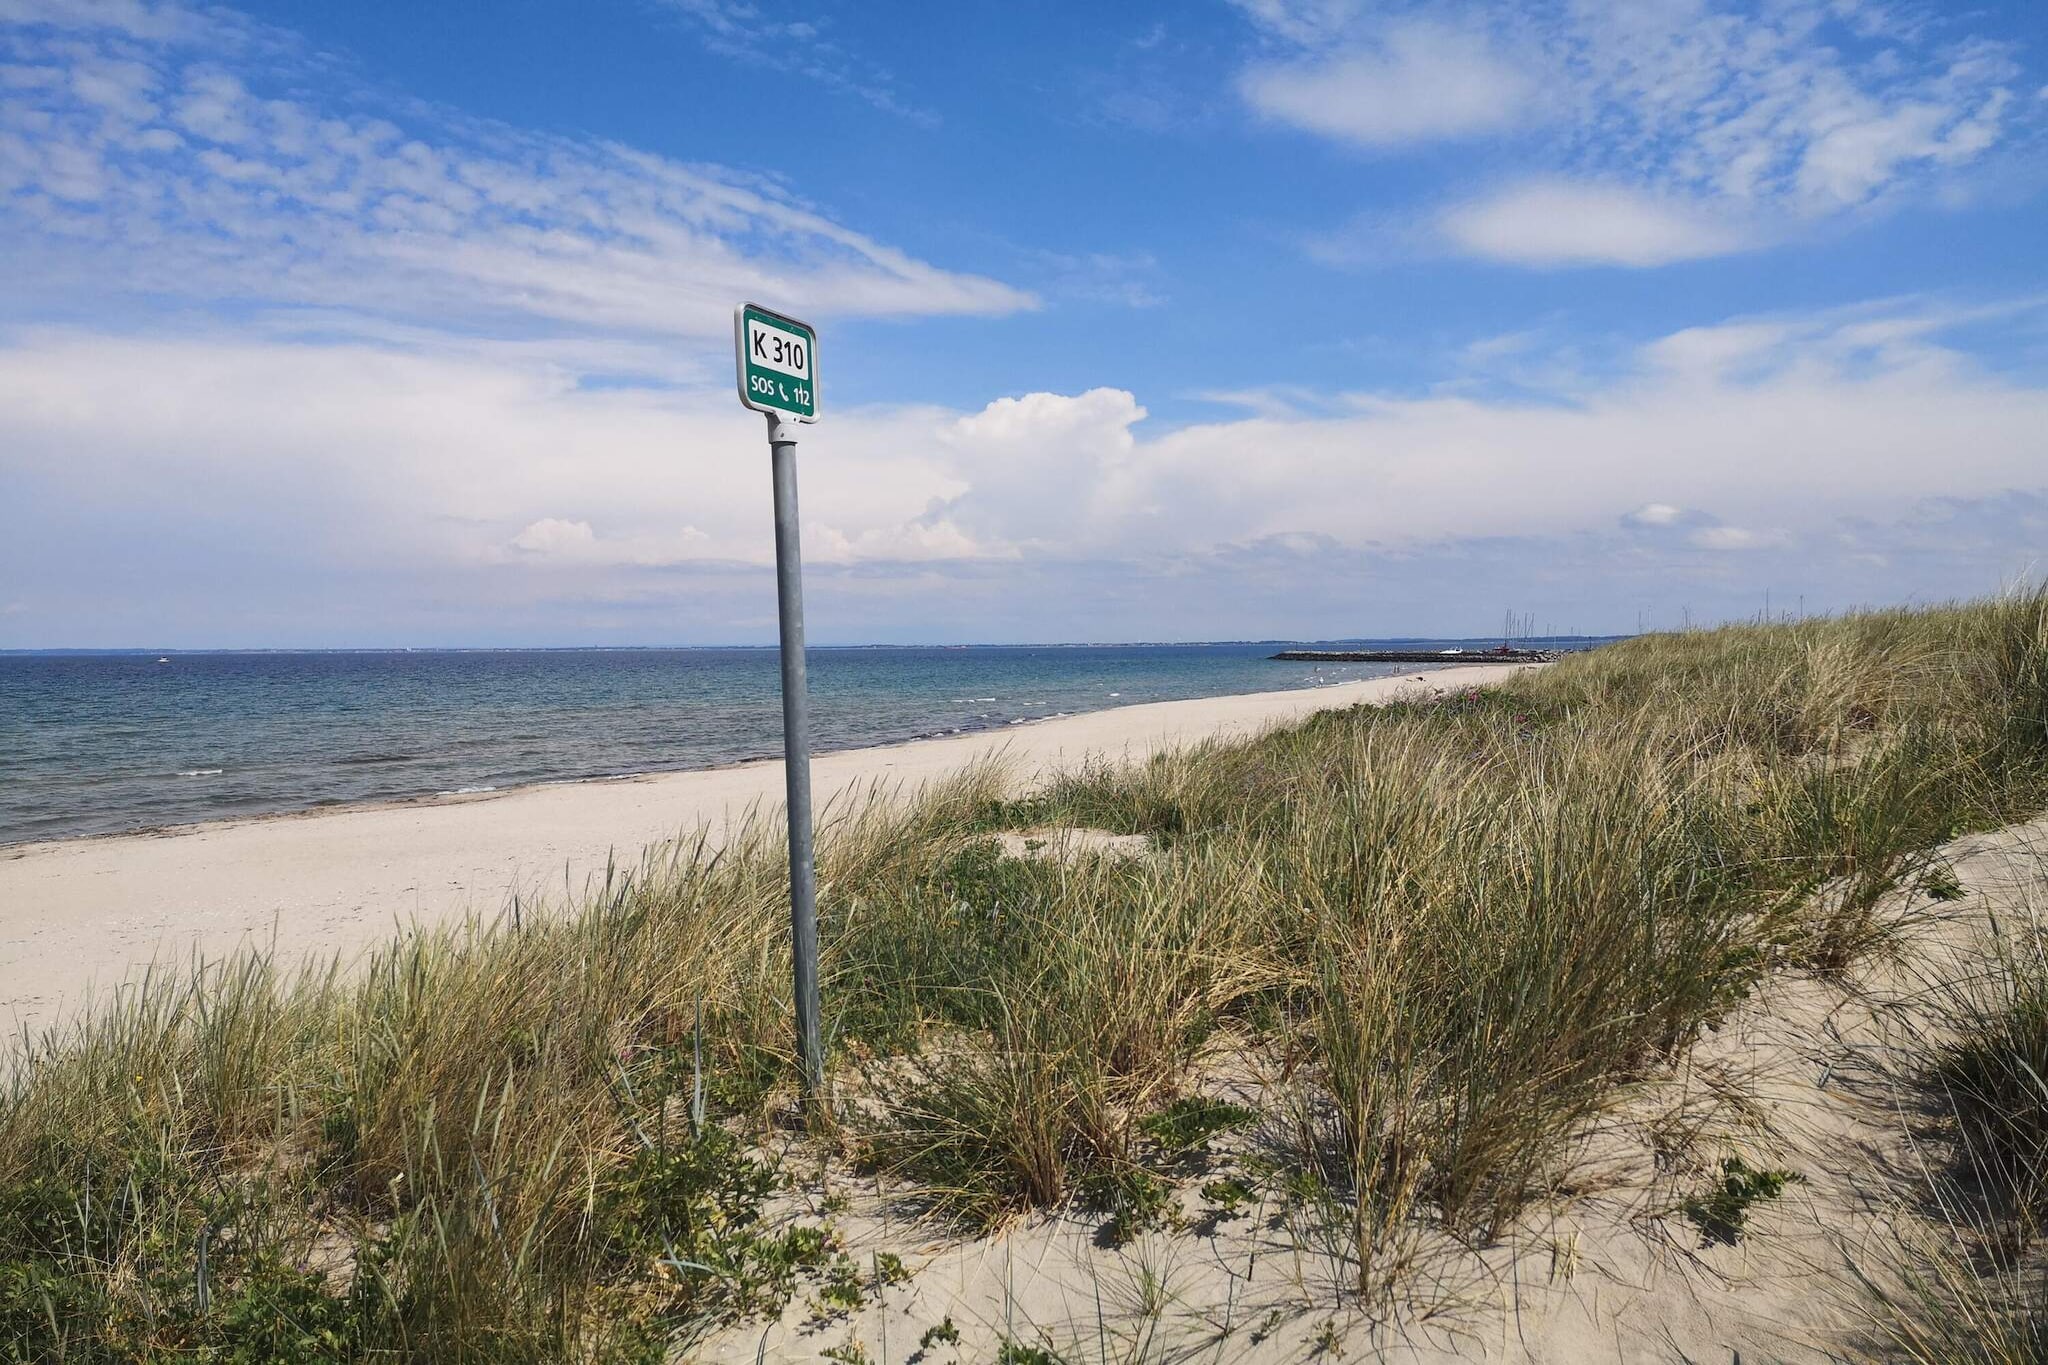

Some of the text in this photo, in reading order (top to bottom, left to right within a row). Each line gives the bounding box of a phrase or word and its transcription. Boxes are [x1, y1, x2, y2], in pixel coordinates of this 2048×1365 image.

[753, 329, 804, 370] K 310
[751, 375, 811, 406] SOS 112
